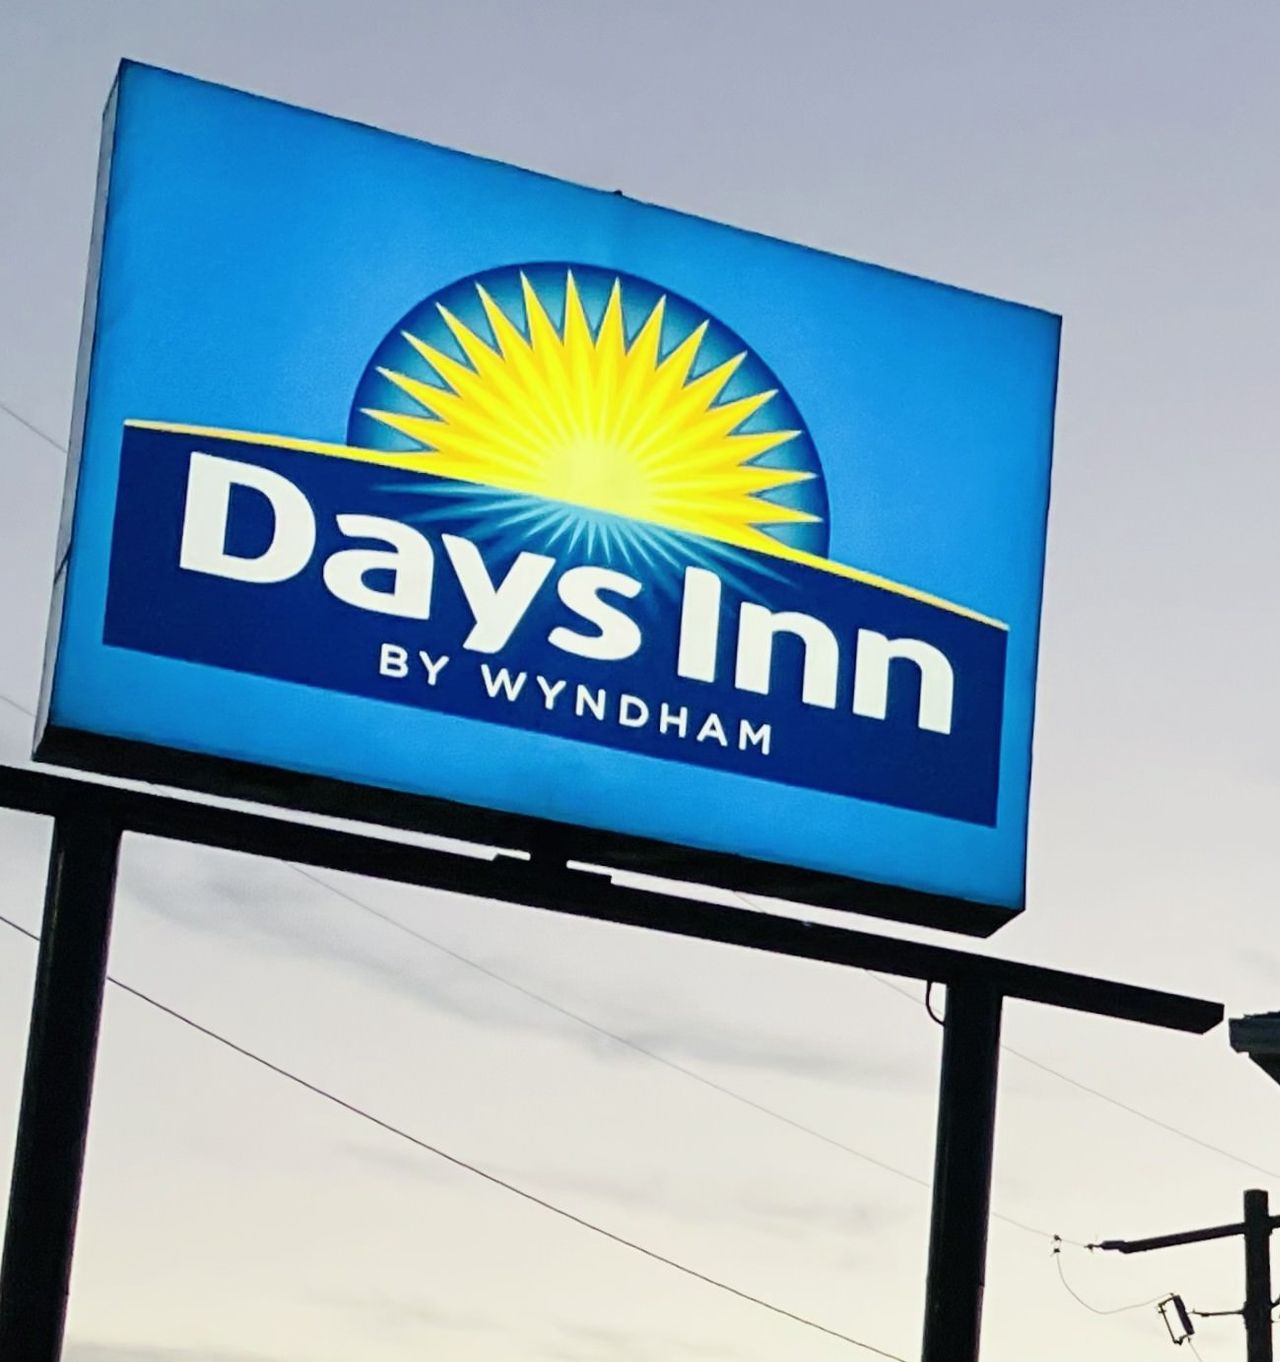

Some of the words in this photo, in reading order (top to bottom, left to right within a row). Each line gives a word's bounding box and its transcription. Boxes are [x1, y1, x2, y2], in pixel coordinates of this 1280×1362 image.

[178, 450, 643, 661] Days
[676, 565, 955, 736] Inn
[378, 642, 450, 686] BY
[480, 663, 772, 756] WYNDHAM
